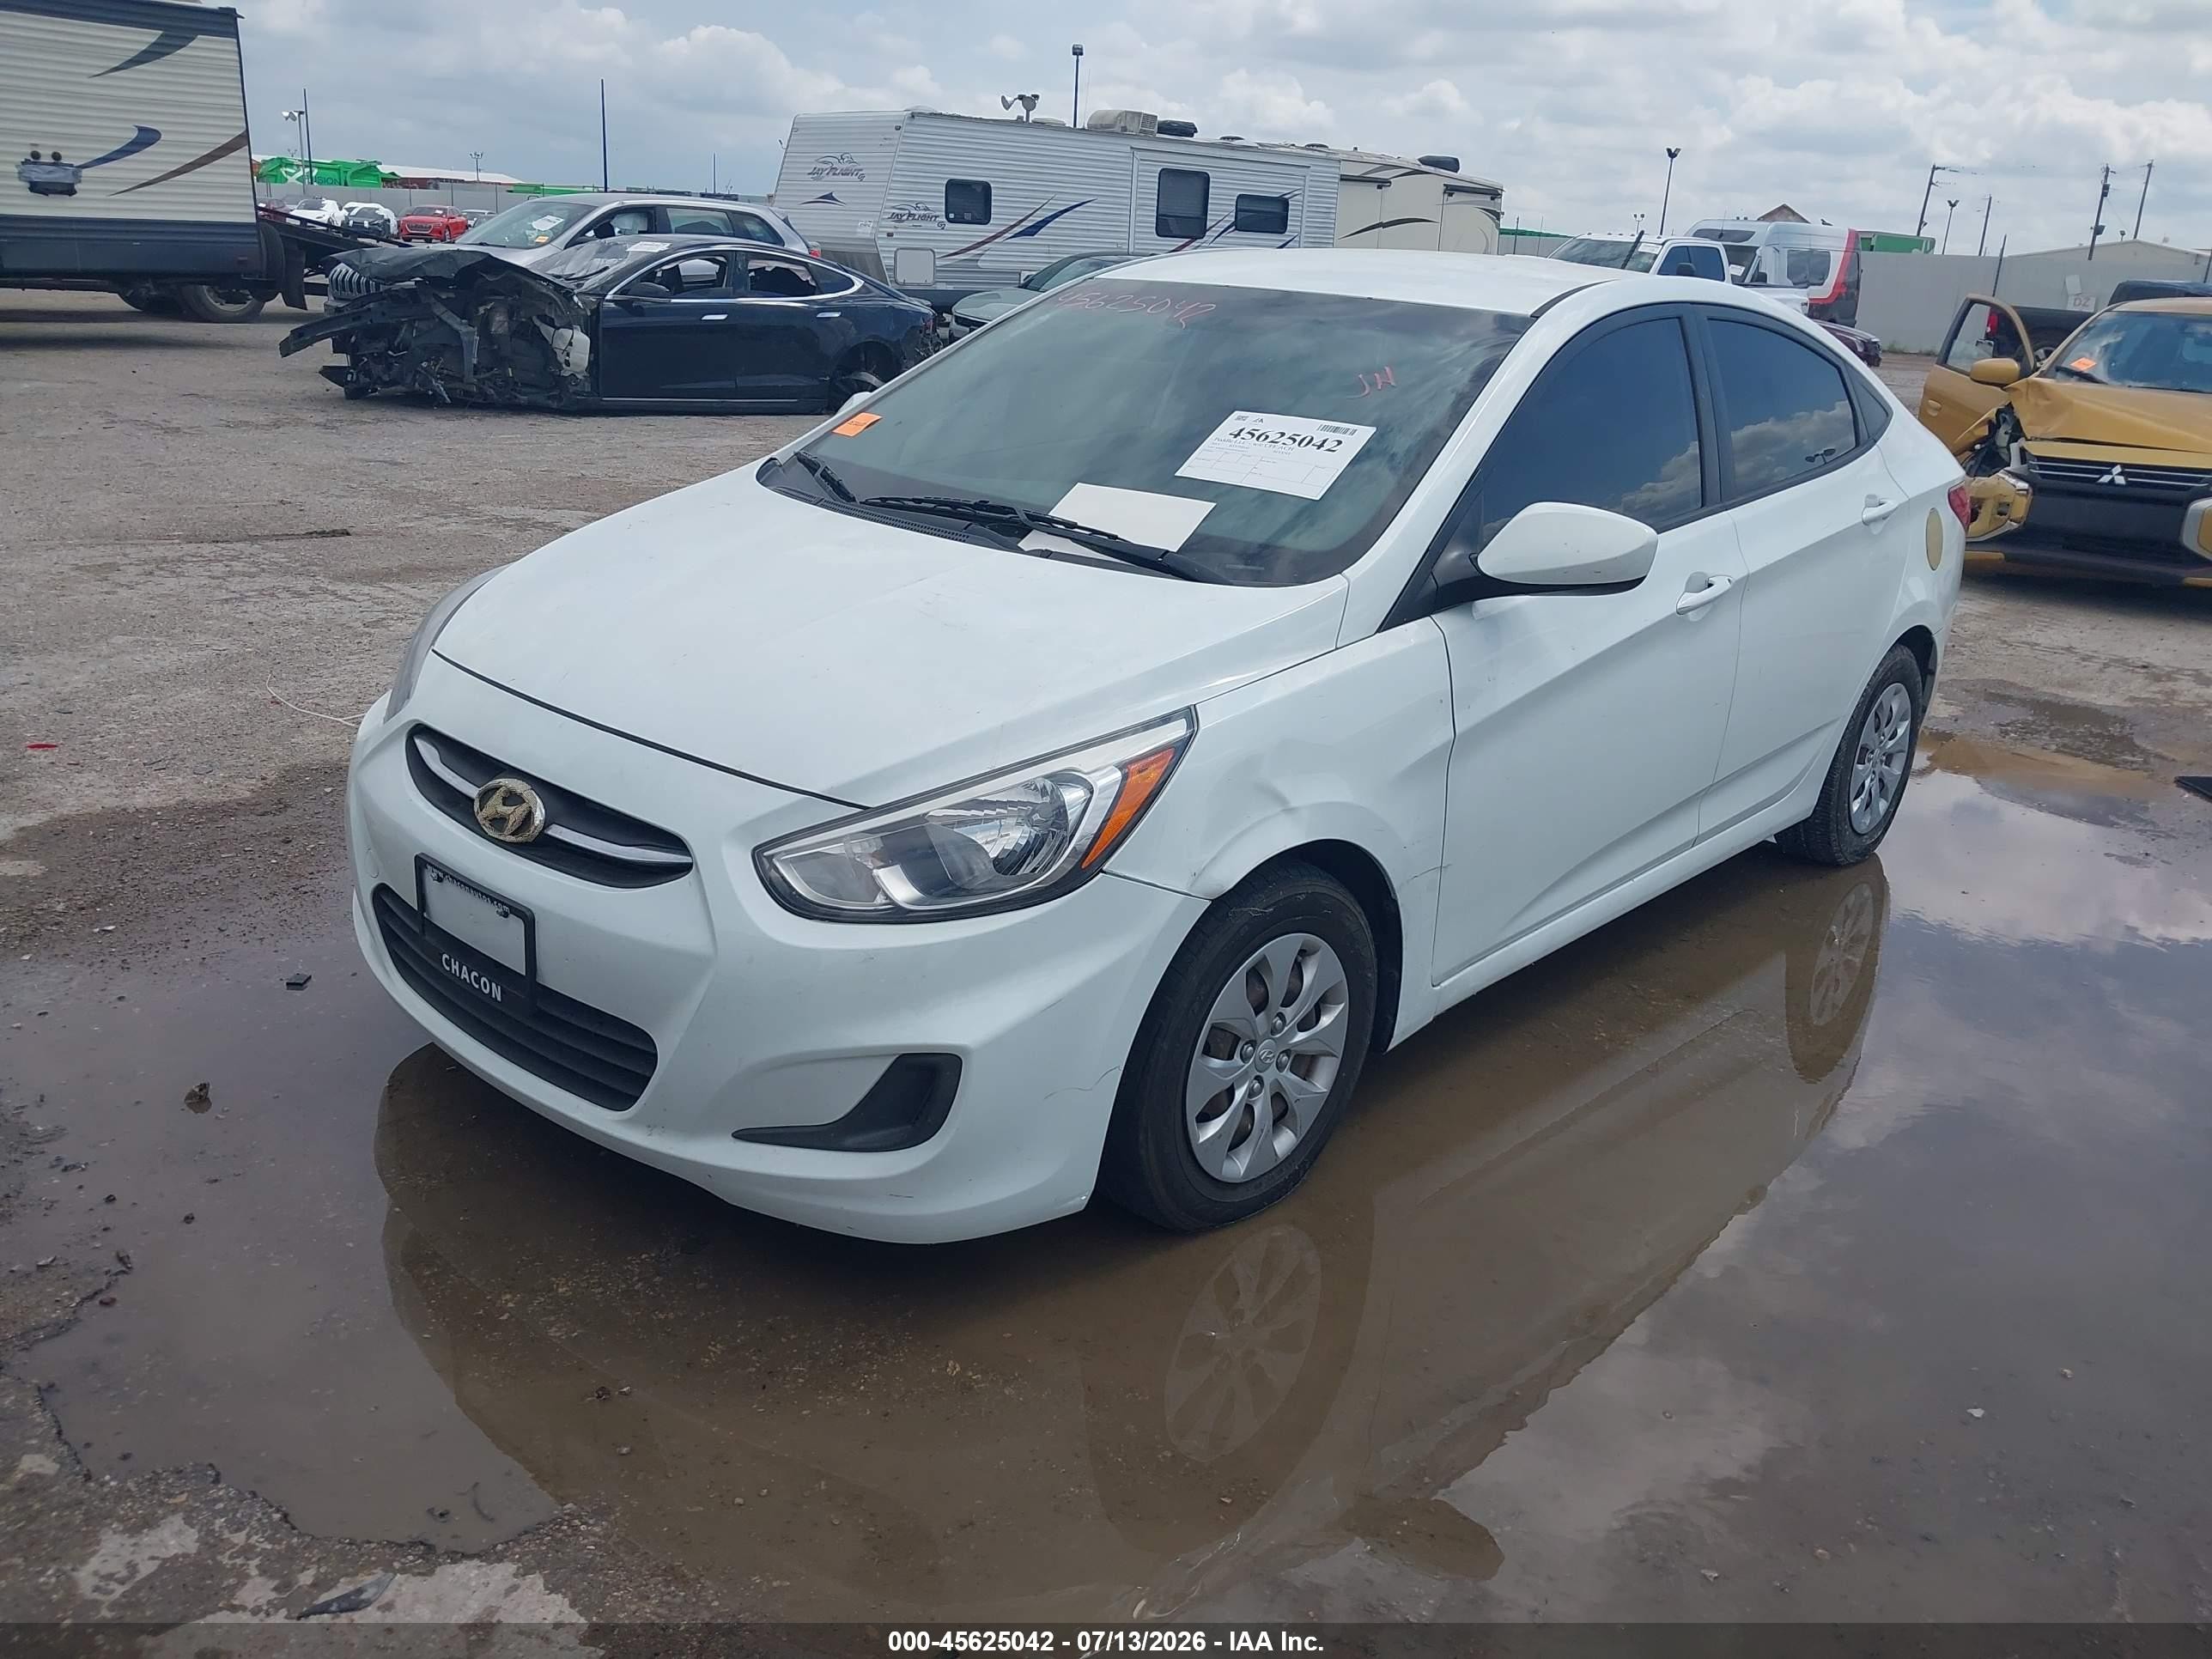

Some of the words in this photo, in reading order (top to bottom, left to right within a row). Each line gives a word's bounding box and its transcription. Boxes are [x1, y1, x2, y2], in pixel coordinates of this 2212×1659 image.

[807, 167, 828, 176] JAY
[825, 167, 864, 177] FLIGHT
[887, 211, 907, 221] JAY
[906, 212, 940, 222] FLIGHT
[1057, 291, 1217, 330] 45625042
[1228, 426, 1343, 453] 45625042
[441, 952, 502, 1003] CHACON
